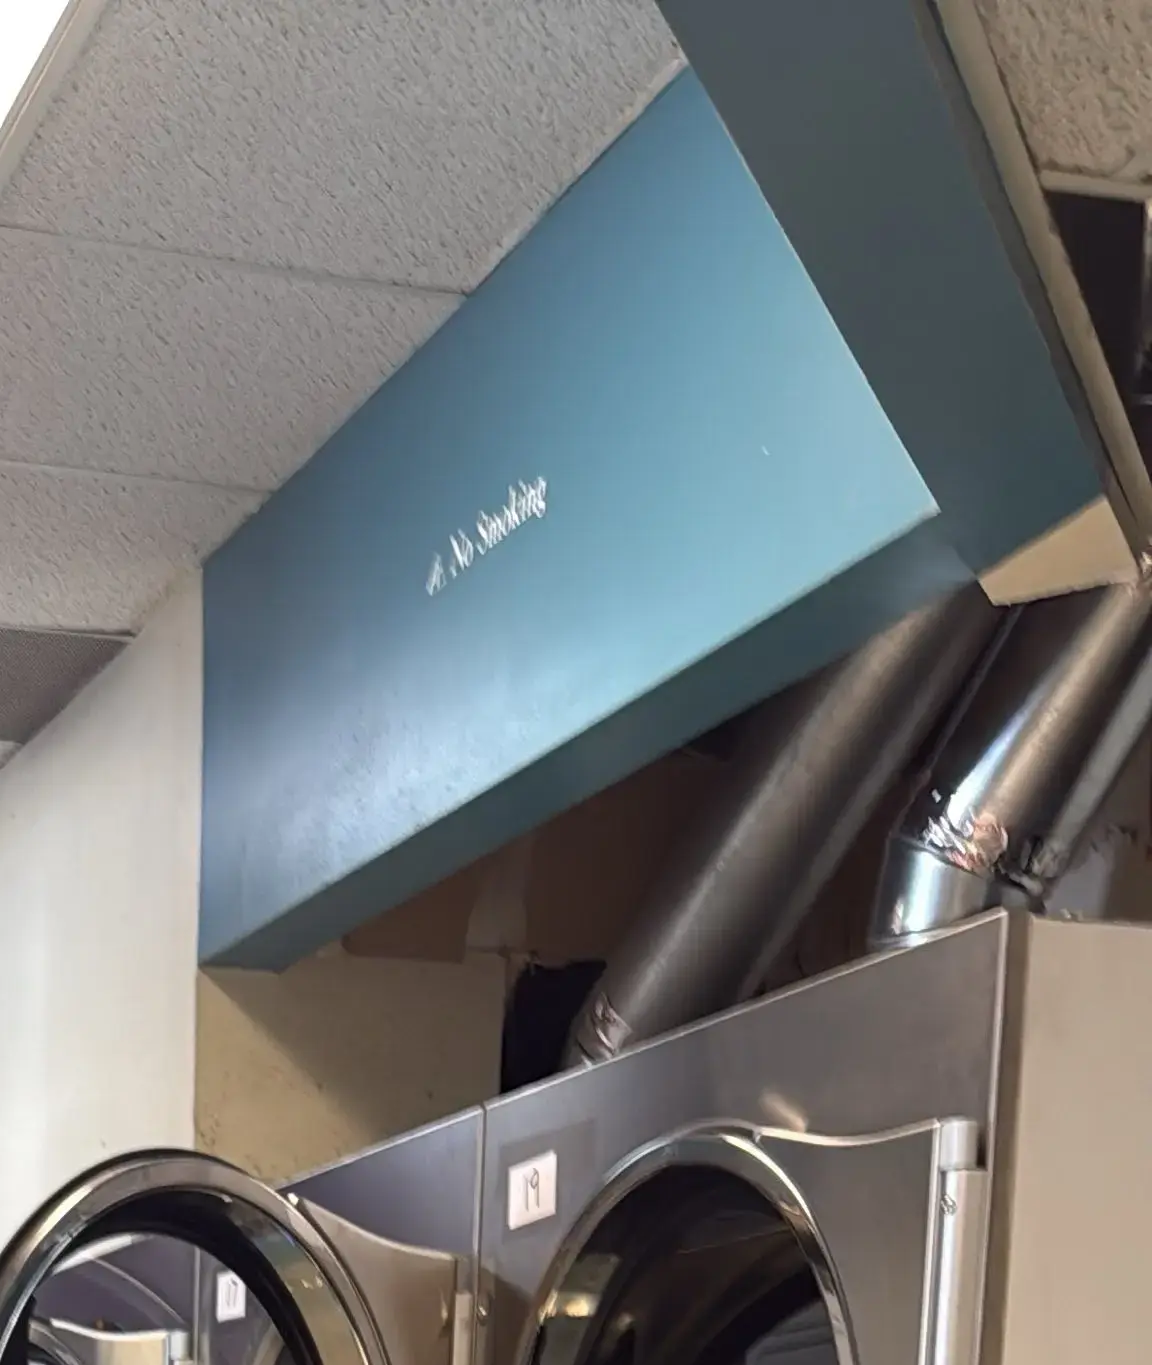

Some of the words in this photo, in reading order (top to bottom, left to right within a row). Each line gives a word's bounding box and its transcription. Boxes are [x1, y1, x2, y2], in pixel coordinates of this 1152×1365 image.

[449, 528, 474, 578] No
[476, 476, 547, 556] Smoking
[523, 1167, 540, 1212] 19
